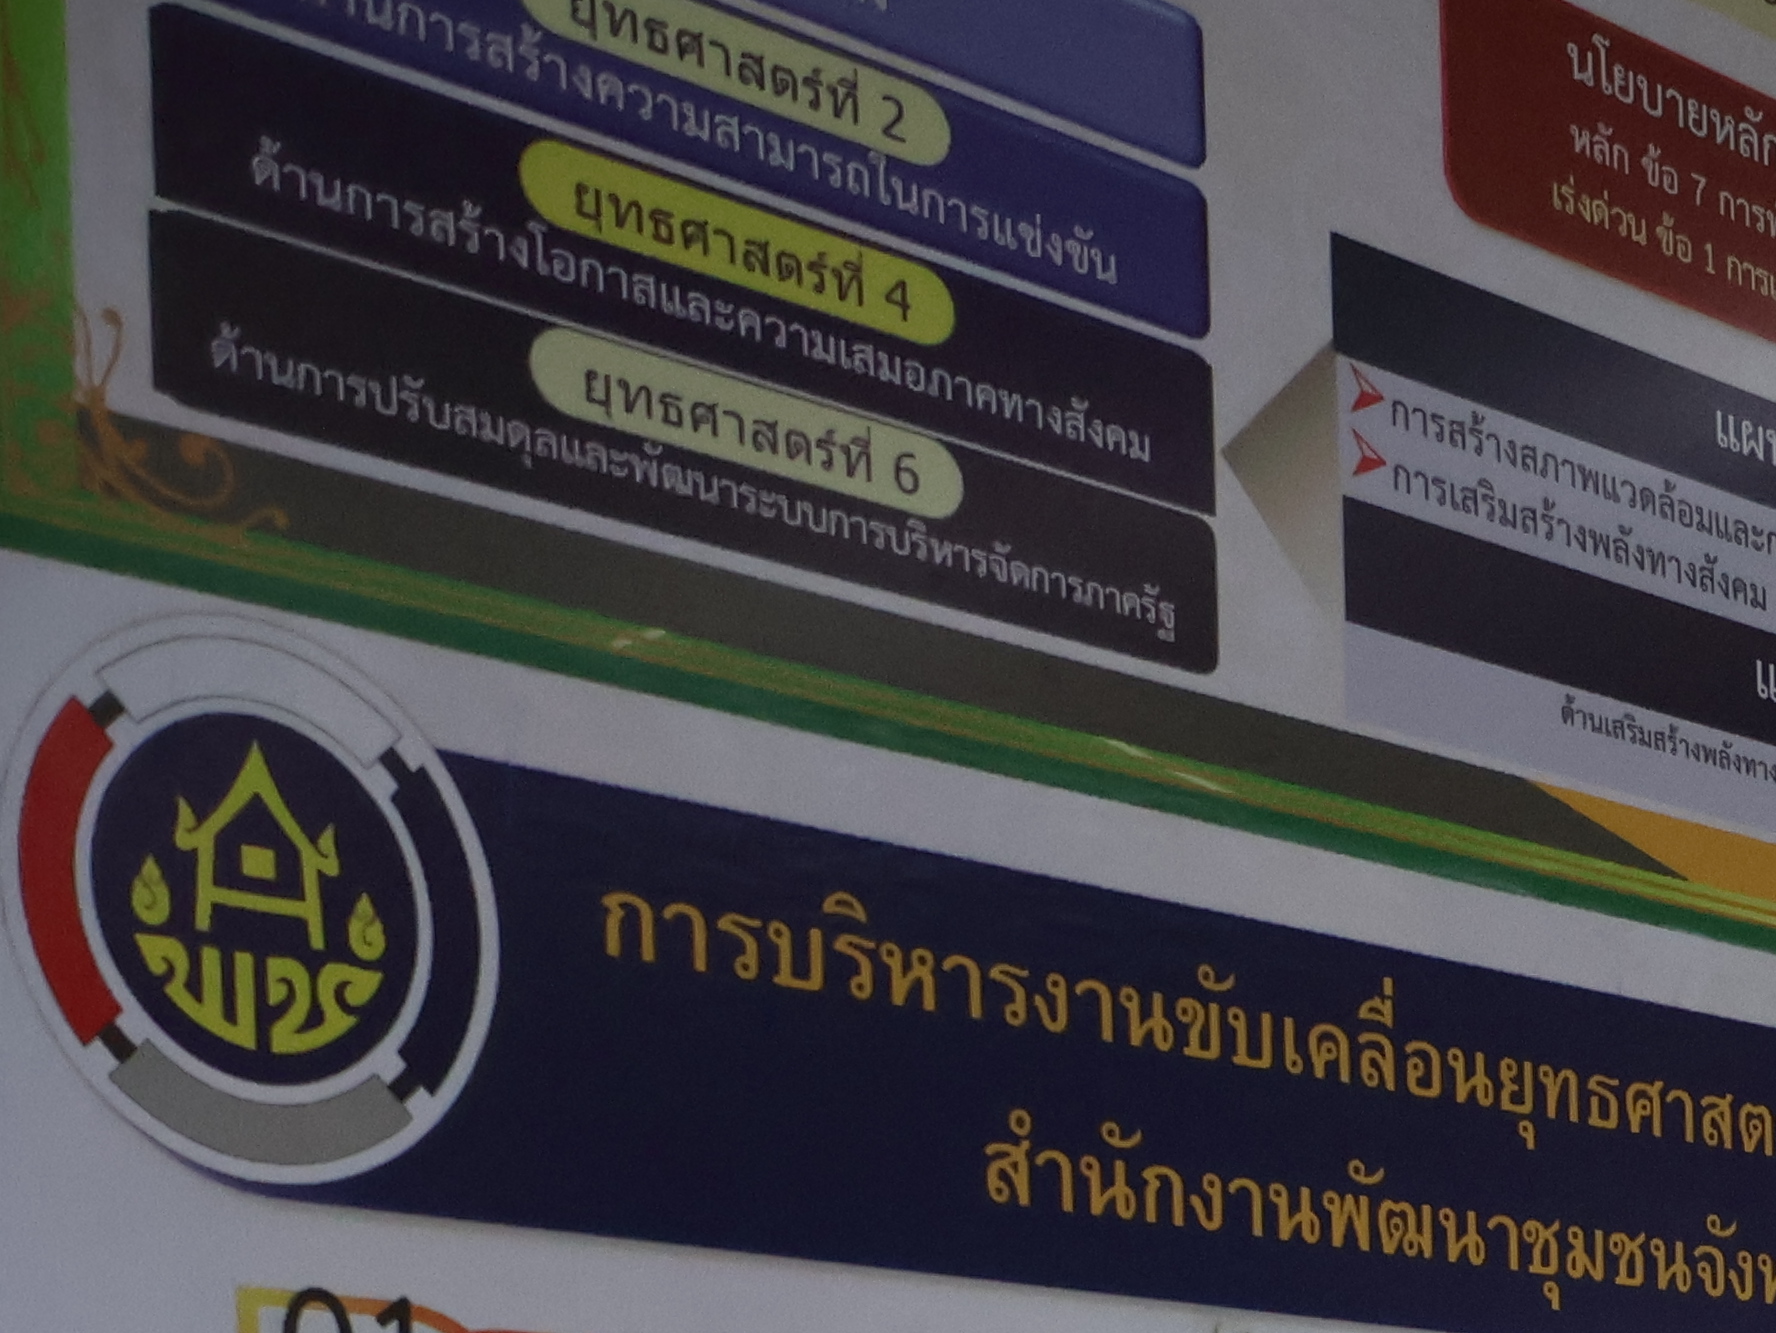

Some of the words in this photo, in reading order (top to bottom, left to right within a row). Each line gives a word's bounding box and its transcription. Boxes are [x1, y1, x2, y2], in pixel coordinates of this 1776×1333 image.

[881, 95, 907, 143] 2
[1570, 117, 1631, 179] หลัก
[1640, 145, 1680, 194] ข้อ
[1690, 171, 1708, 206] 7
[574, 176, 864, 311] ยุทธศาสตร์ที่
[881, 272, 913, 323] 4
[1552, 178, 1646, 247] เร่งด่วน
[1656, 211, 1693, 262] ข้อ
[1703, 236, 1718, 273] 1
[583, 361, 872, 487] ยุทธศาสตร์ที่
[893, 446, 922, 497] 6
[1392, 455, 1768, 614] การเสริมสร้างพลังทางสังคม
